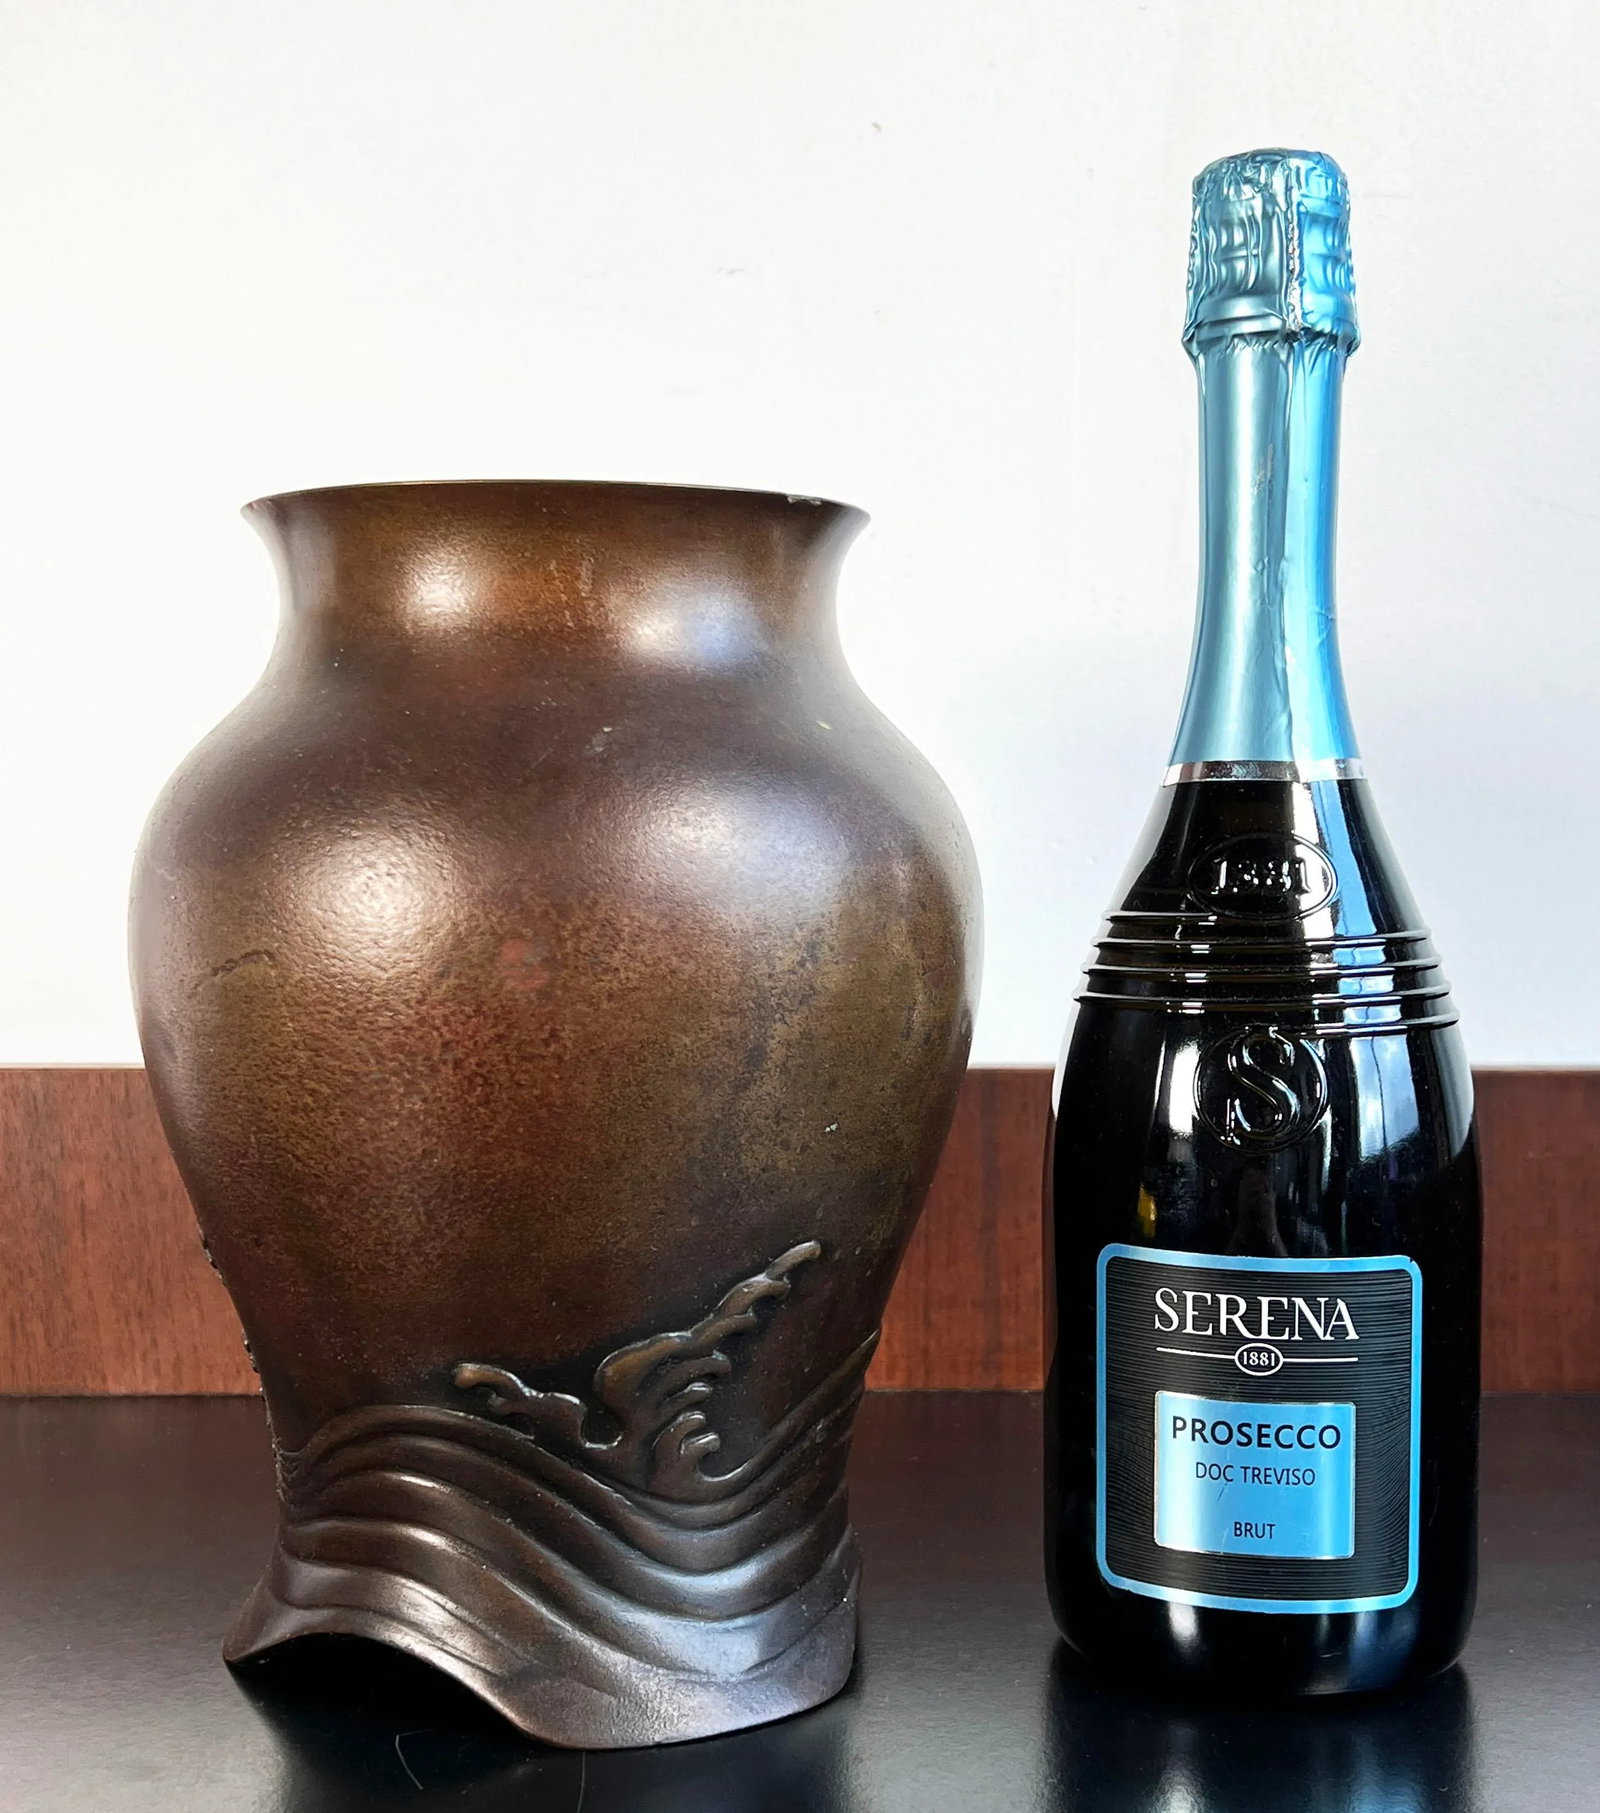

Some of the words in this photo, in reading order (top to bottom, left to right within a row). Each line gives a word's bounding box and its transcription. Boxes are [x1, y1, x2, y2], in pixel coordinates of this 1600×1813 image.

[1154, 1287, 1360, 1341] SERENA
[1242, 1350, 1277, 1367] 1881
[1172, 1415, 1341, 1449] PROSECCO
[1195, 1461, 1233, 1483] DOC
[1240, 1466, 1316, 1486] TREVISO
[1233, 1521, 1276, 1539] BRUT
